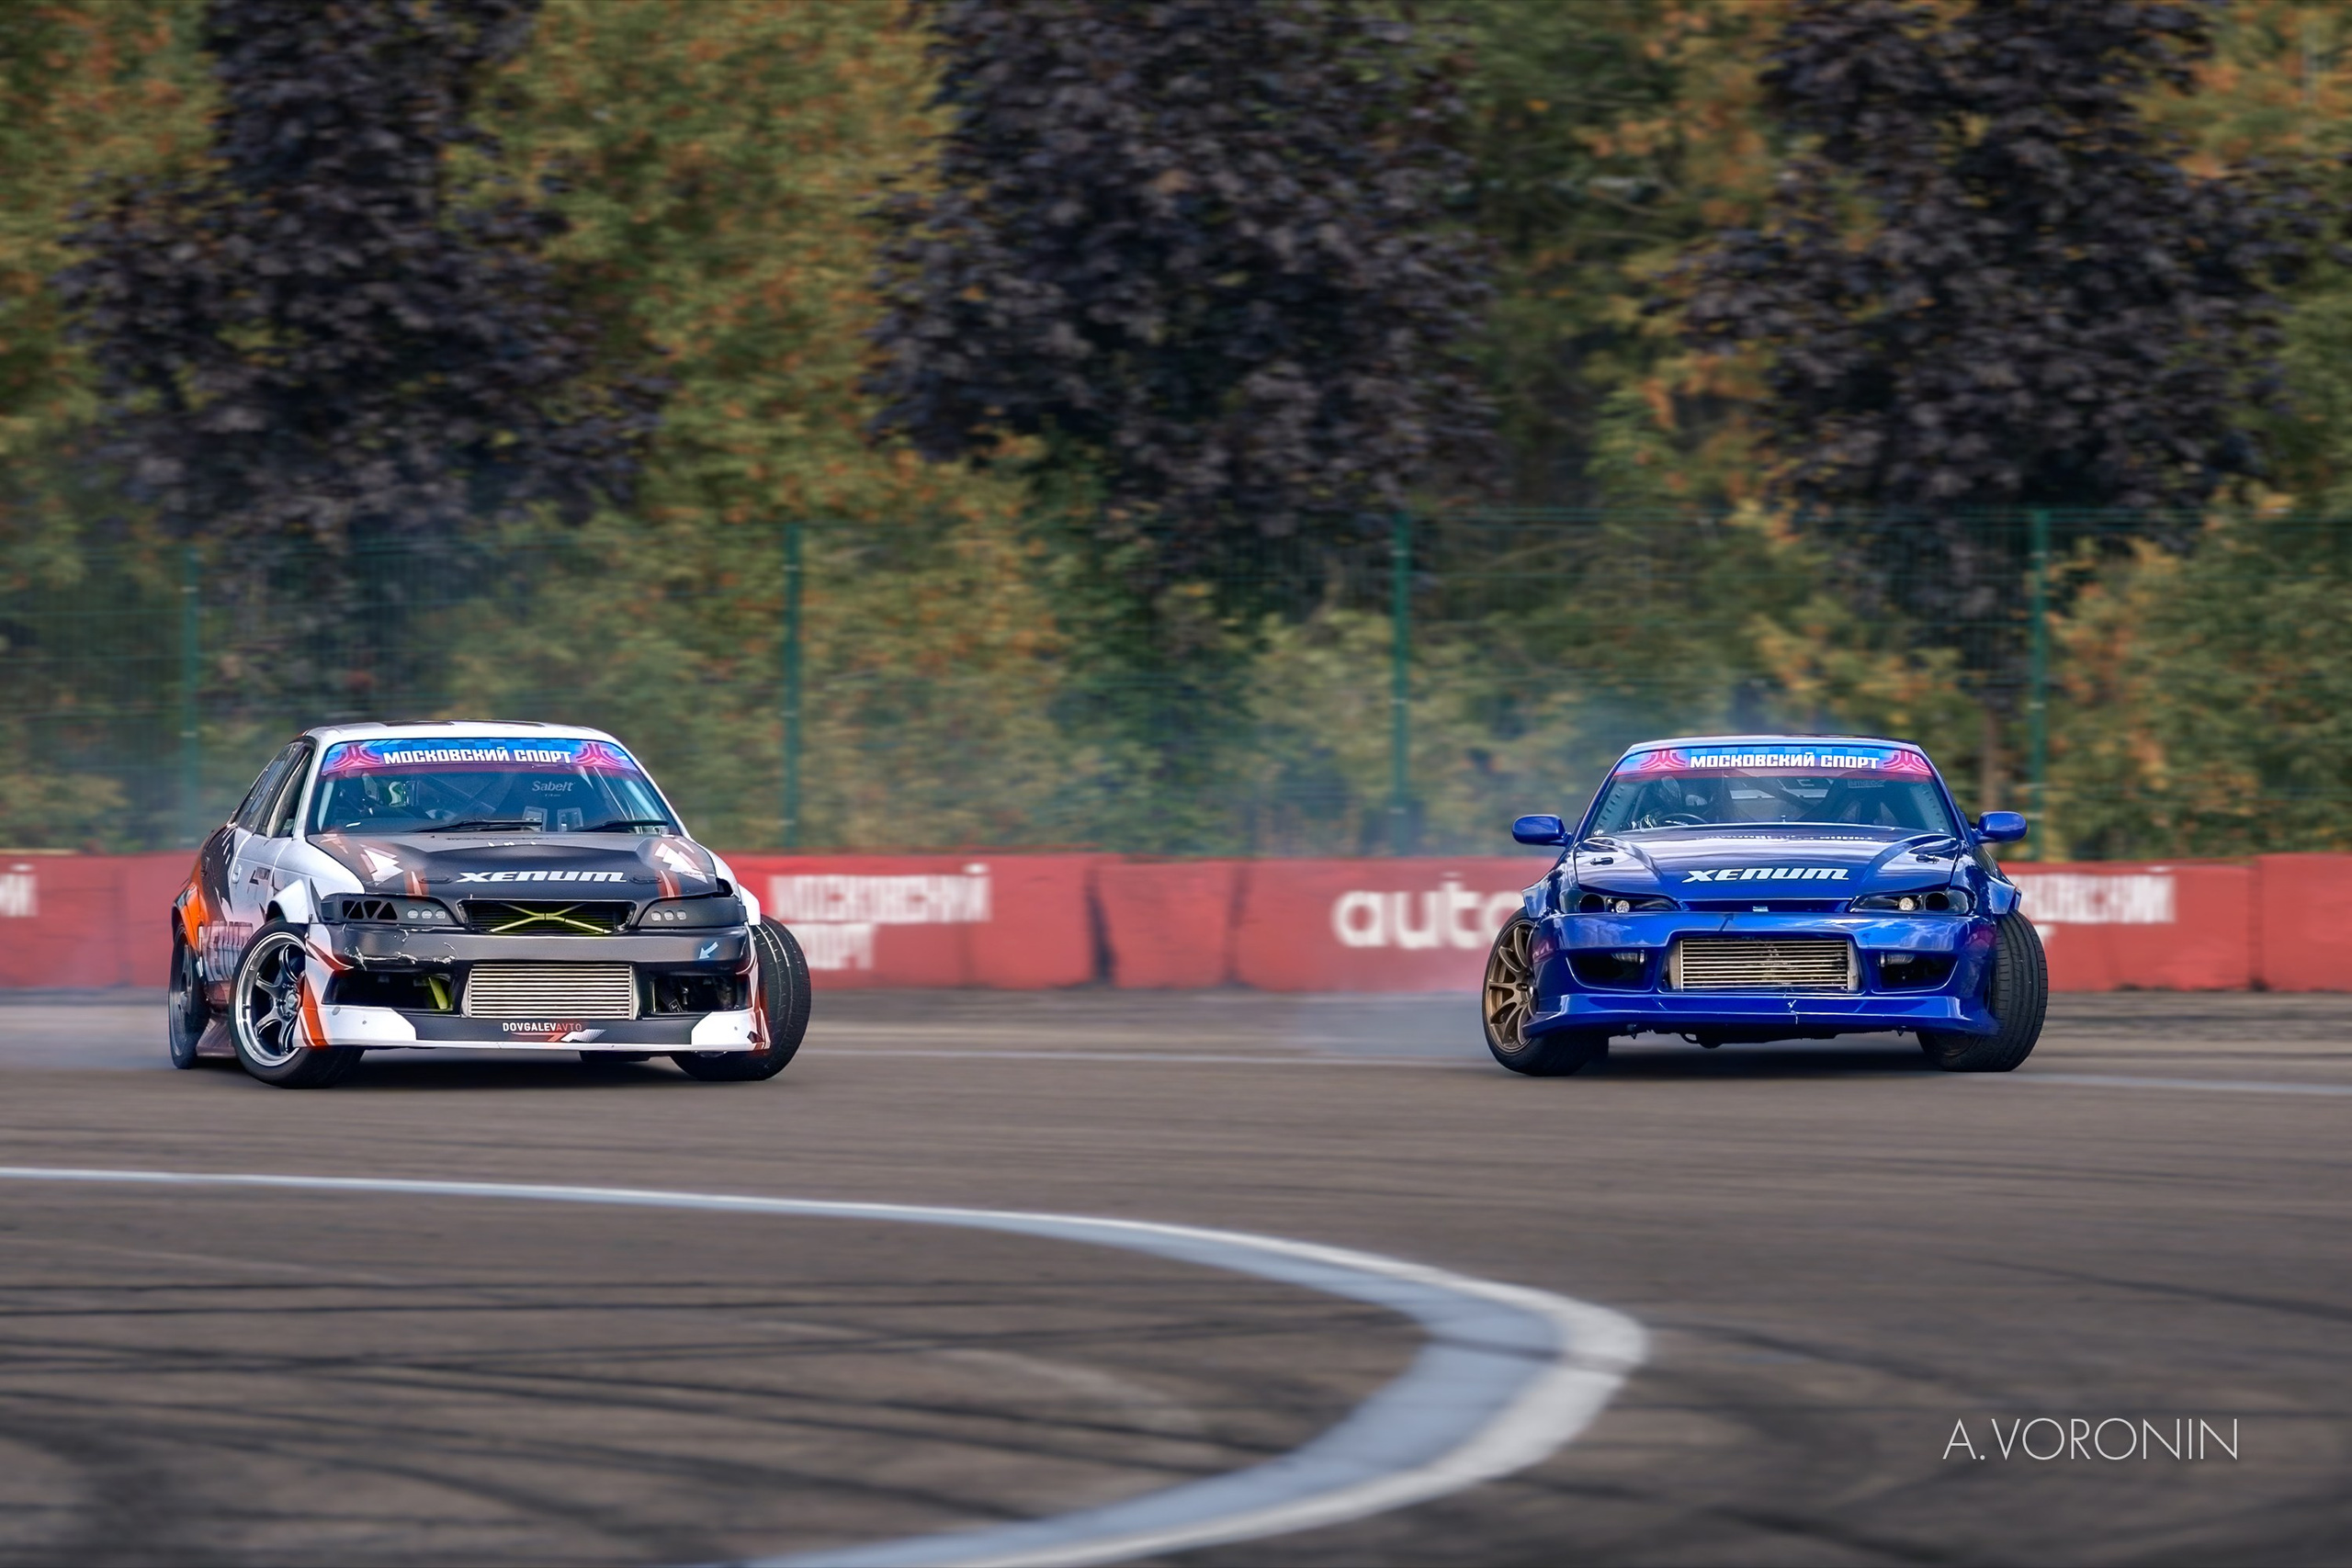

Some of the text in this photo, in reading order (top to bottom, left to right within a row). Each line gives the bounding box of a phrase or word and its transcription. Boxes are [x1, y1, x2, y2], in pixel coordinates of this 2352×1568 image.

[383, 746, 571, 764] МОСКОВСКИЙ СПОРТ
[1690, 751, 1880, 769] МОСКОВСКИЙ СПОРТ
[532, 781, 573, 791] Sabelt
[456, 871, 628, 883] XENUM
[1681, 867, 1849, 884] XENUM
